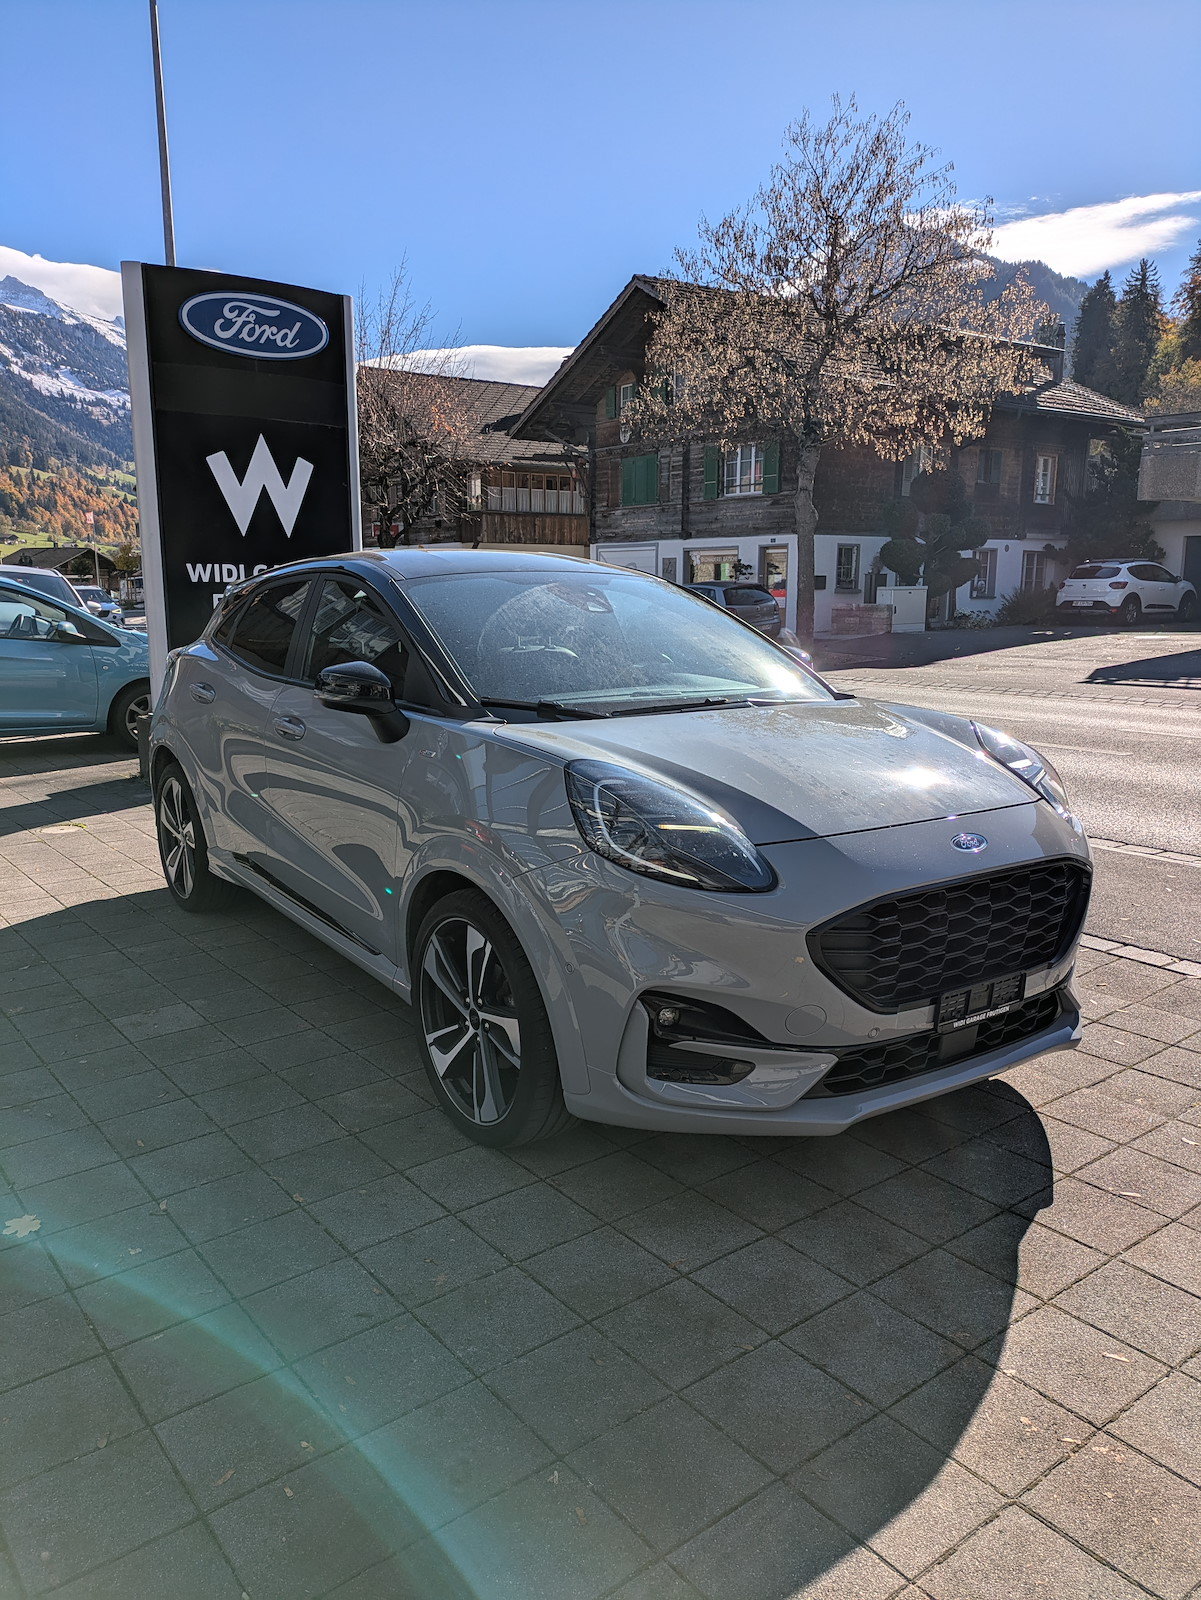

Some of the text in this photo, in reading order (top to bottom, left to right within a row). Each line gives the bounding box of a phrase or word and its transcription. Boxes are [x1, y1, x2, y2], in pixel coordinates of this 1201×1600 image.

[213, 301, 301, 348] Ford
[205, 432, 314, 539] W
[185, 563, 246, 583] WIDI
